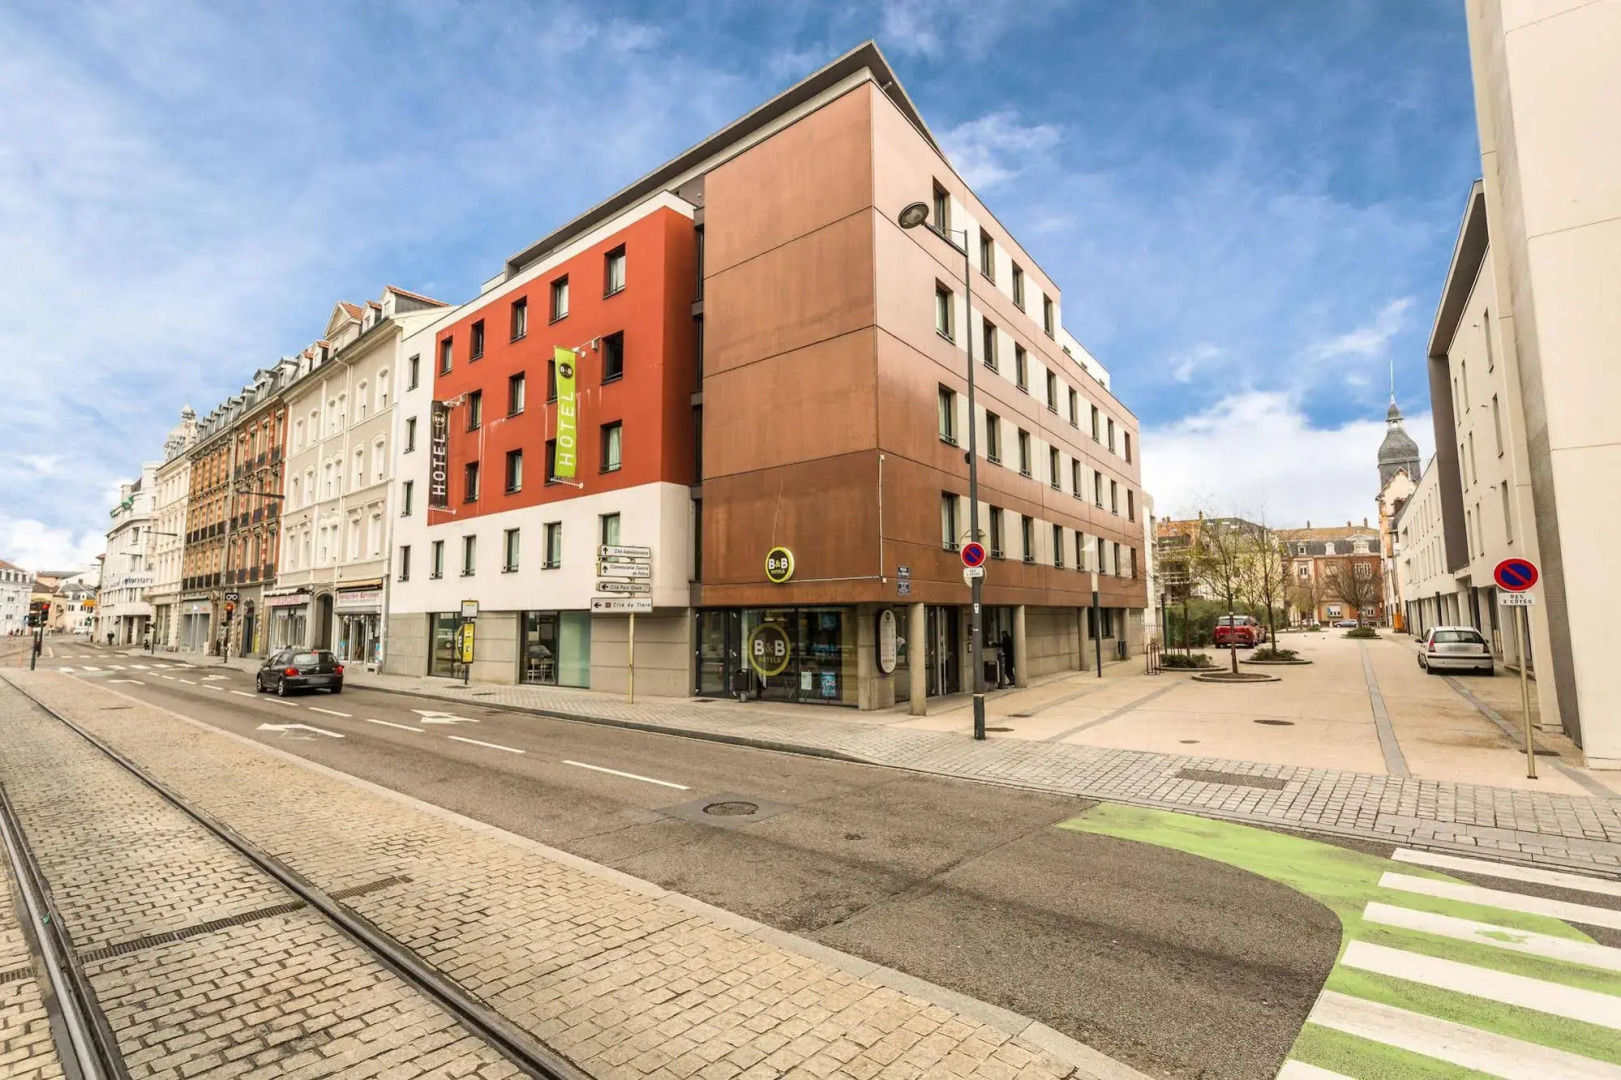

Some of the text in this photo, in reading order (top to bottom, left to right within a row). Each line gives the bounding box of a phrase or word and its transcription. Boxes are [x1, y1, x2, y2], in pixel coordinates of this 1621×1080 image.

[560, 392, 574, 466] HOTEL
[432, 434, 446, 496] HOTEL
[768, 558, 788, 570] B&B
[754, 640, 785, 656] B&B
